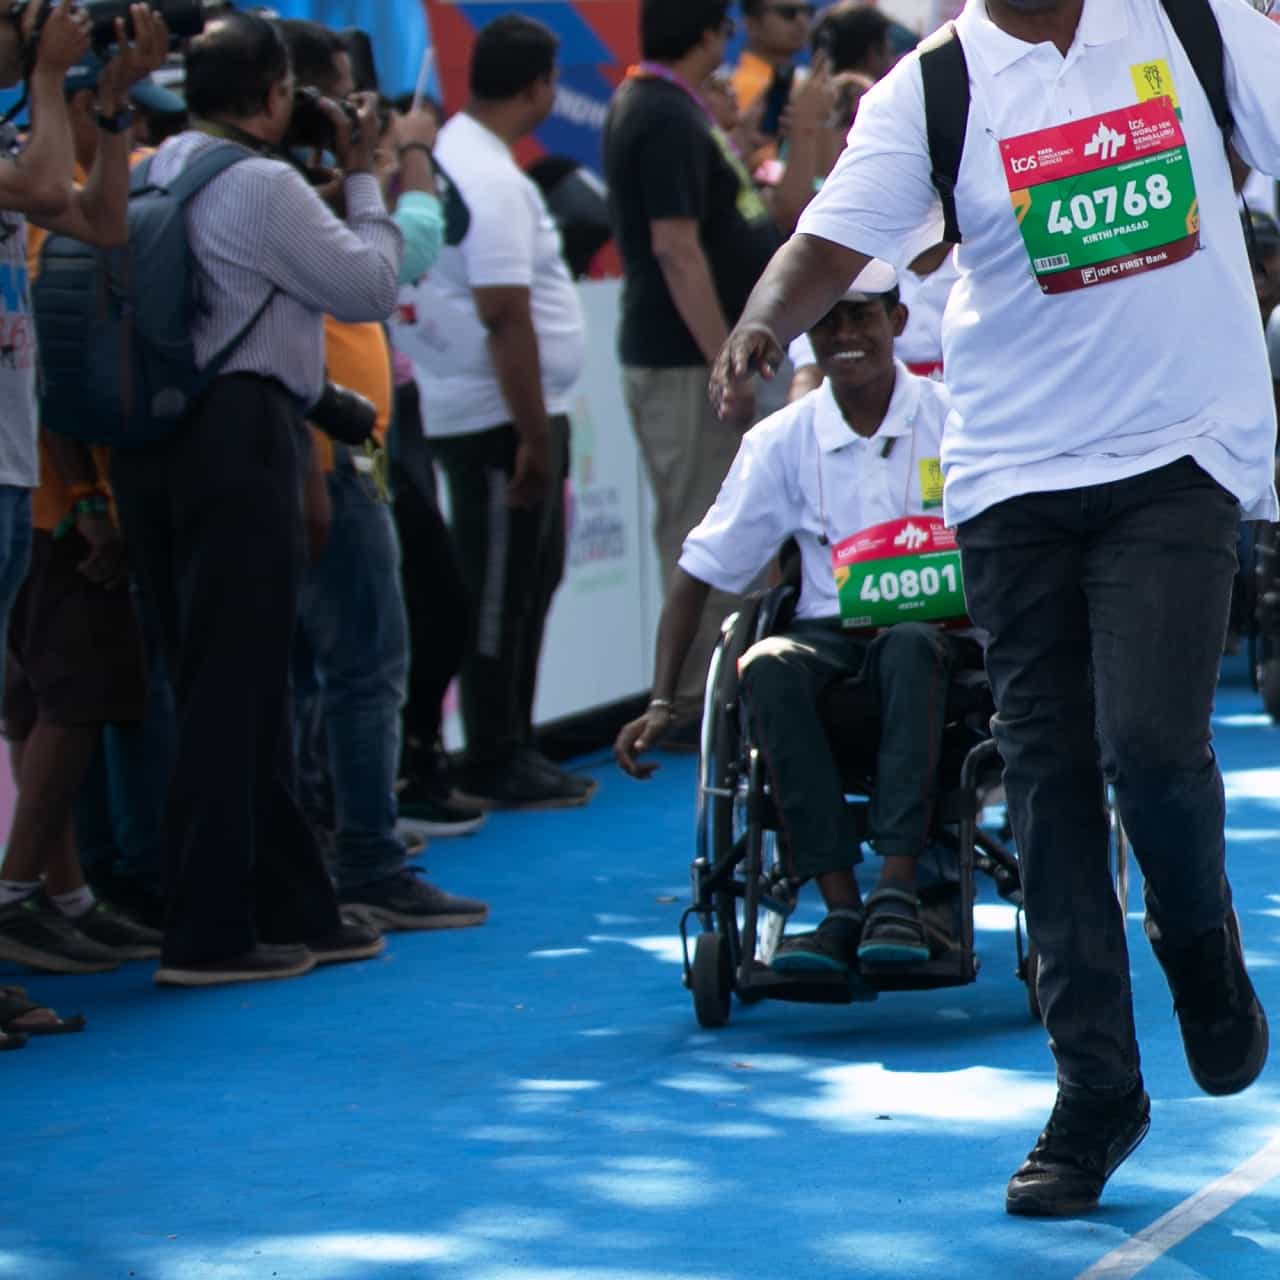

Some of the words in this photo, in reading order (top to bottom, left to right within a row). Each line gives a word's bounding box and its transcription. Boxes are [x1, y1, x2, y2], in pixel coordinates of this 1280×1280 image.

[1010, 154, 1038, 174] tcs
[1046, 173, 1173, 236] 40768
[1082, 229, 1113, 246] KIRTHI
[1113, 220, 1149, 237] PRASAD
[1119, 257, 1144, 272] FIRST
[1145, 251, 1168, 265] Bank
[859, 563, 958, 603] 40801
